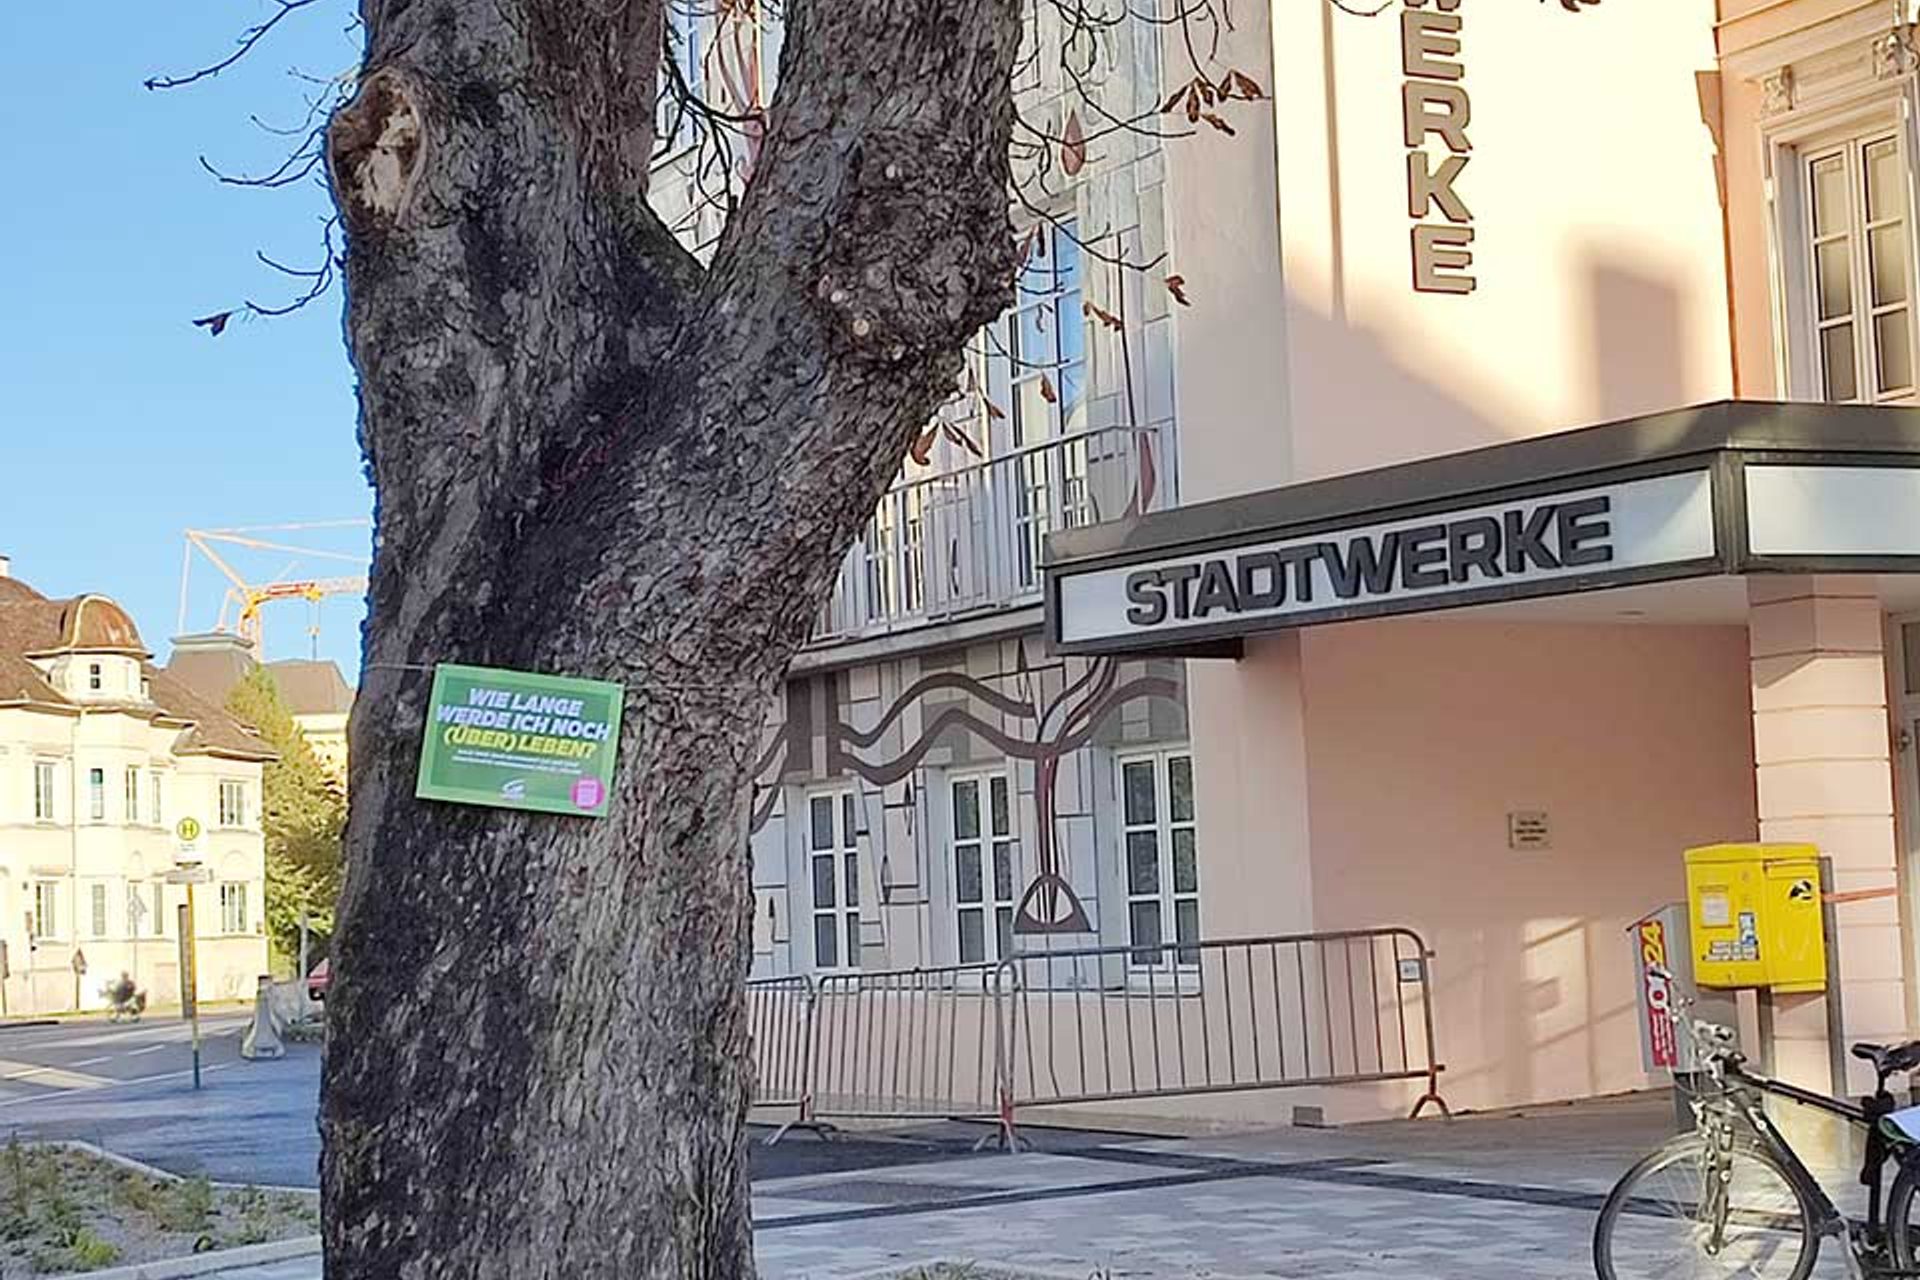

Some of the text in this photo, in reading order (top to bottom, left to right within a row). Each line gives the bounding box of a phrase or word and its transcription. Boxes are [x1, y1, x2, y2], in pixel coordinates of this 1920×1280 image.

[1400, 0, 1477, 296] ERKE
[1126, 495, 1613, 627] STADTWERKE
[436, 704, 612, 741] WERDE ICH NOCH
[468, 688, 584, 717] WIE LANGE
